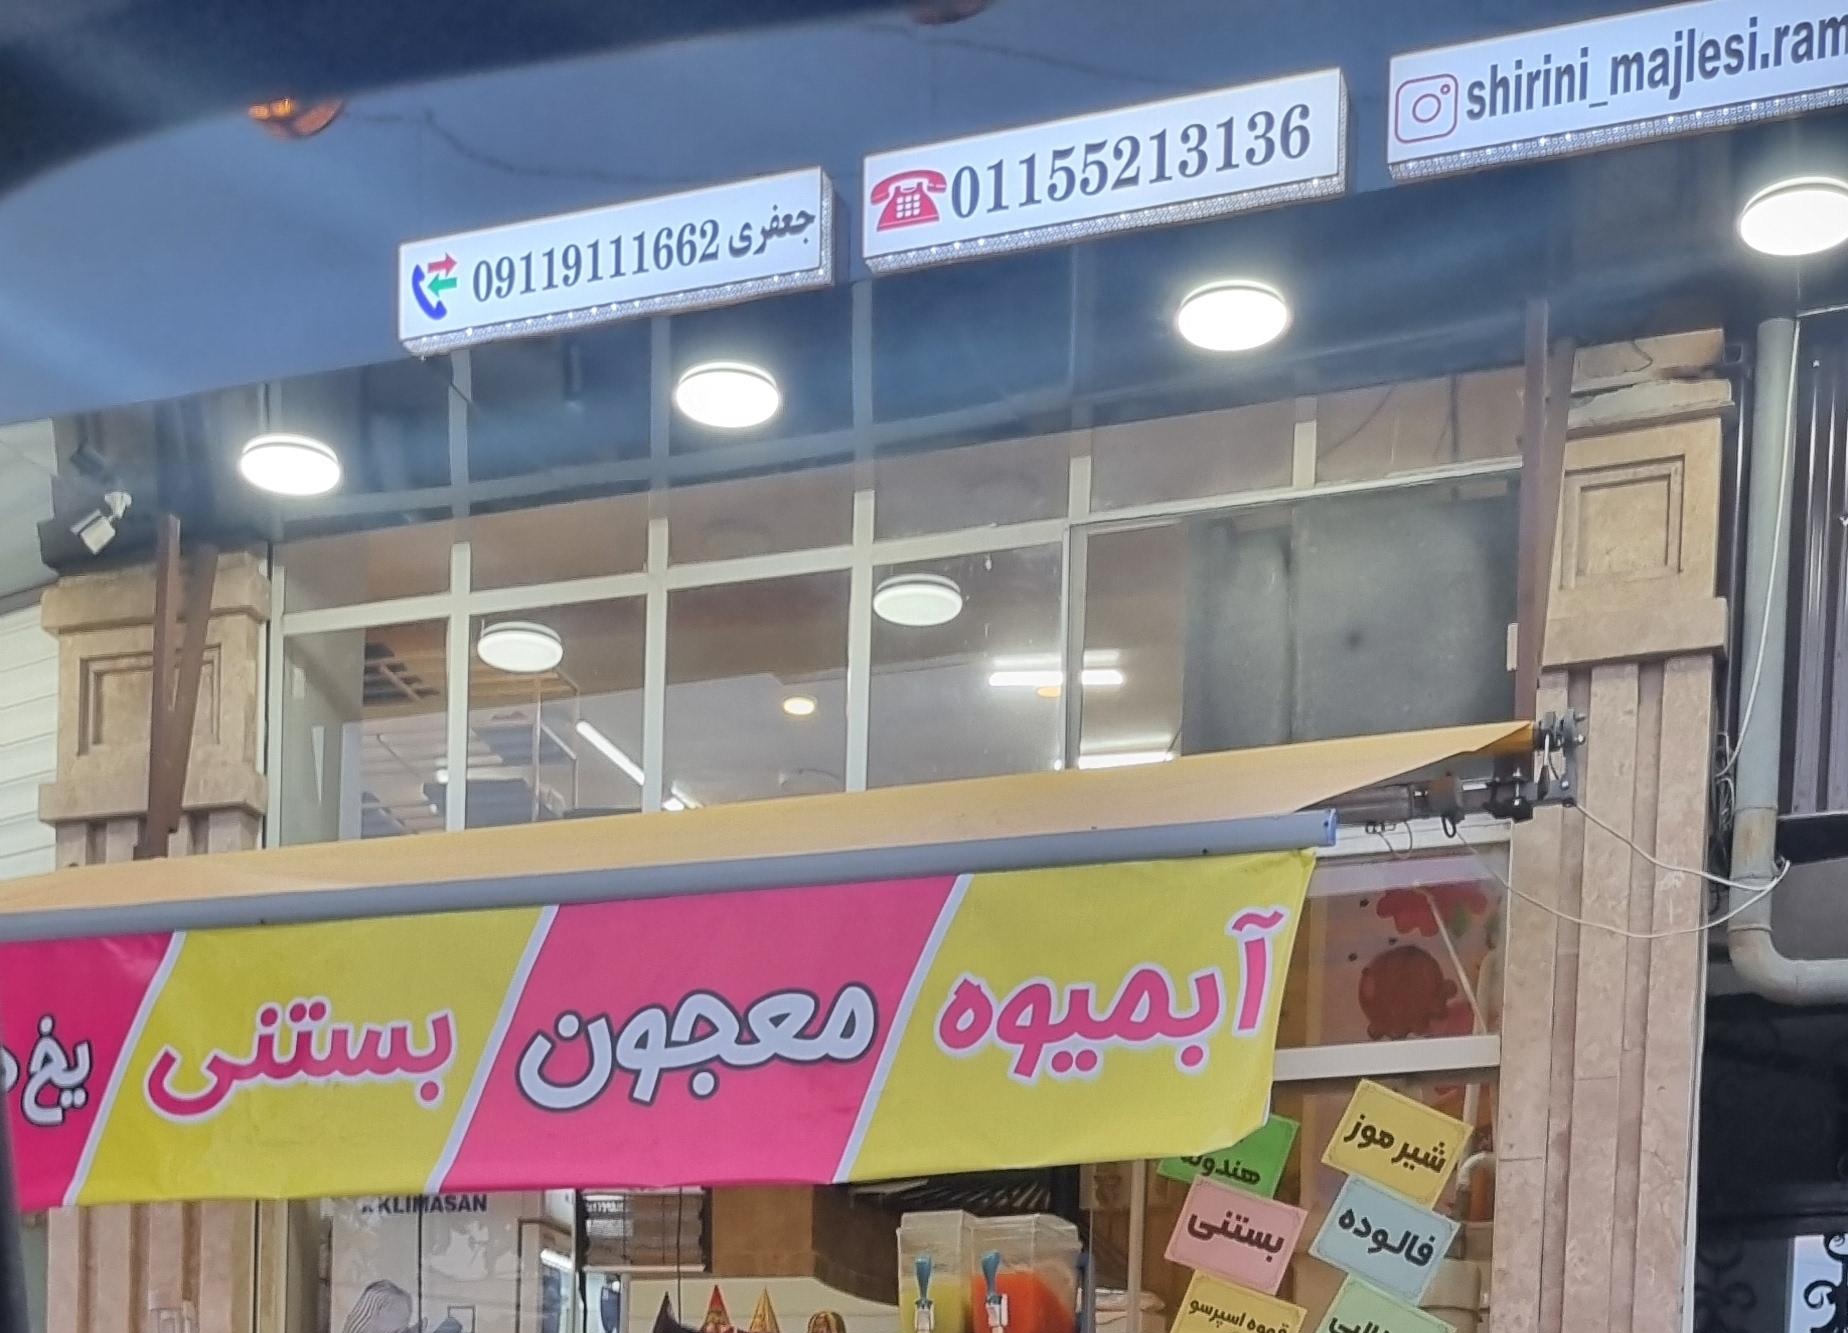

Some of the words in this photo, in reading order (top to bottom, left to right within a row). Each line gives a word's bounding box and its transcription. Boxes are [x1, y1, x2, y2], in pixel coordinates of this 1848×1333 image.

[951, 104, 1311, 219] 01155213136
[473, 219, 720, 302] 09119111662
[728, 207, 816, 258] جعفری
[938, 907, 1286, 1079] آبمیوه
[22, 1015, 91, 1127] یخ
[145, 997, 456, 1121] بستنی
[517, 982, 877, 1113] معجون
[1343, 1114, 1395, 1149] موز
[1391, 1141, 1446, 1173] شیر
[379, 1194, 487, 1214] KLIMASAN
[1187, 1211, 1284, 1263] بستنی
[1339, 1208, 1434, 1266] فالوده
[1189, 1300, 1246, 1328] اسپرسو
